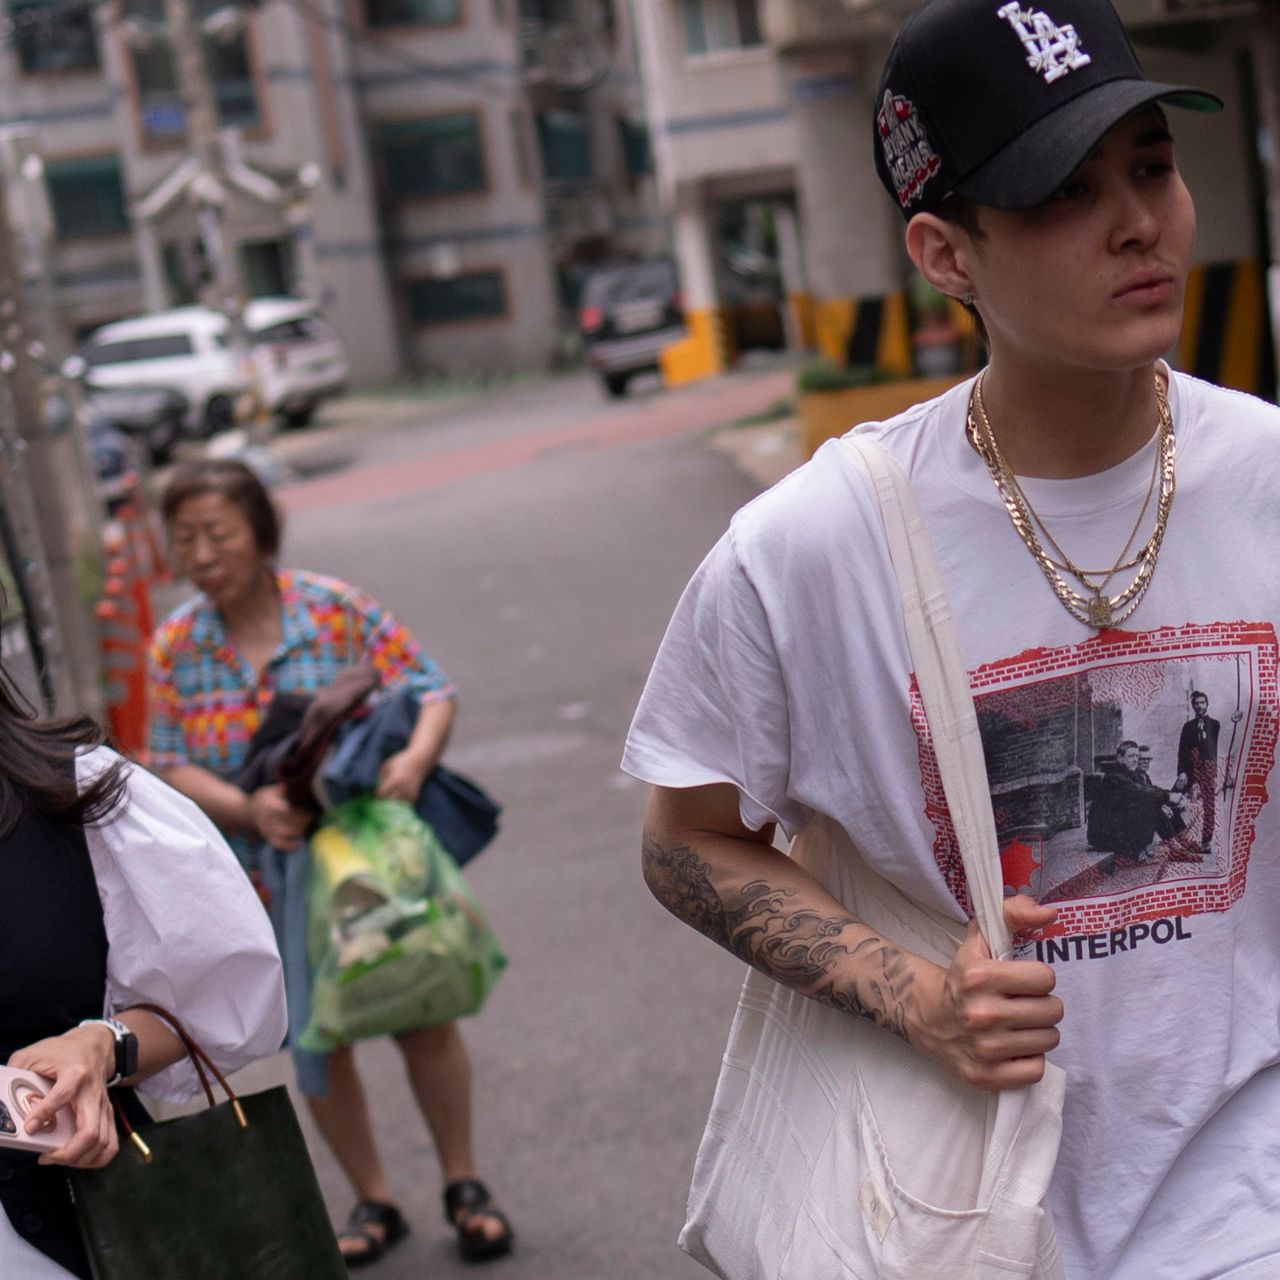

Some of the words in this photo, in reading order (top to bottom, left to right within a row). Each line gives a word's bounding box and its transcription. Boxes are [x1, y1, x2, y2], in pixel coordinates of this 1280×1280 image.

[997, 1, 1091, 84] LA
[890, 140, 932, 188] MEANS
[1036, 917, 1192, 963] INTERPOL
